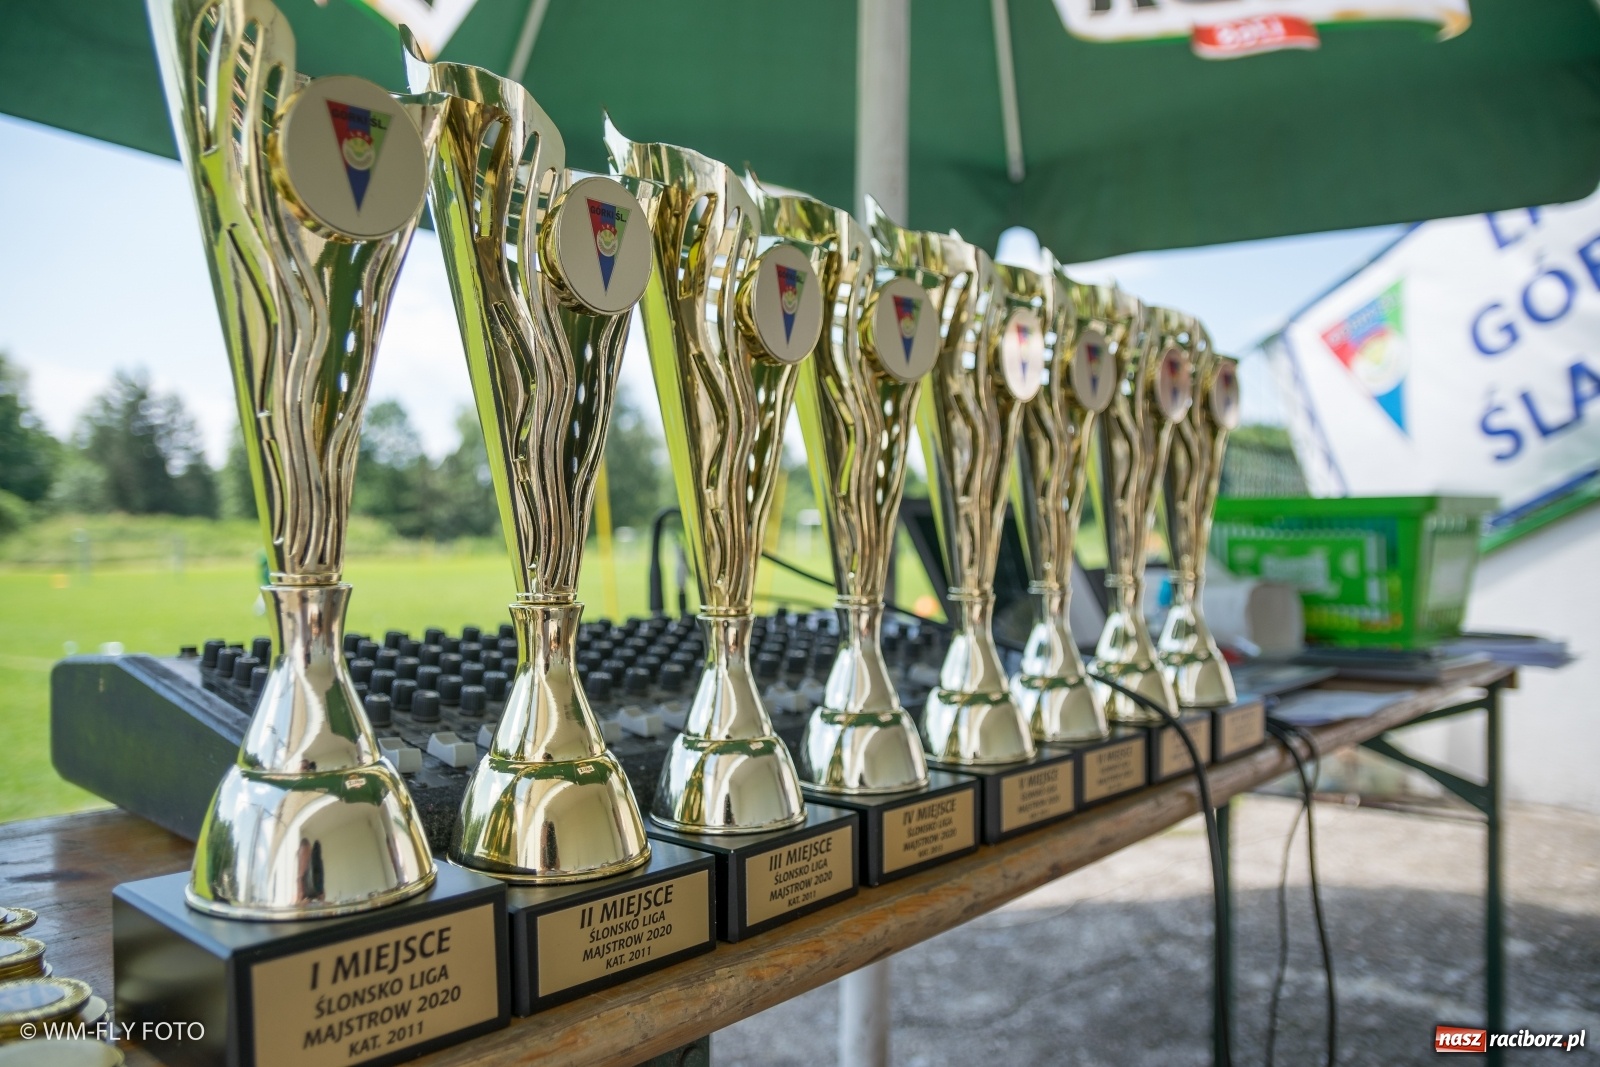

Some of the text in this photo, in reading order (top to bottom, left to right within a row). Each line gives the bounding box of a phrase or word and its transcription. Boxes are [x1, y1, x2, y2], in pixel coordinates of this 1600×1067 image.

[590, 205, 627, 223] GÓRKI ŚL.
[903, 797, 957, 826] IV MIEJSCE
[769, 837, 832, 872] III MIEJSCE
[774, 857, 829, 886] ŚLONSKO LIGA
[769, 870, 833, 902] MAJSTROW 2020
[787, 889, 816, 908] KAT. 2011
[580, 883, 673, 930] II MIEJSCE
[582, 923, 673, 962] MAJSTROW 2020
[589, 910, 666, 944] ŚLONSKO LIGA
[310, 926, 452, 991] I MIEJSCE
[605, 945, 652, 970] KAT. 2011
[314, 964, 450, 1020] ŚLONSKO LIGA
[302, 985, 462, 1050] MAJSTROW 2020
[348, 1020, 424, 1058] KAT. 2011
